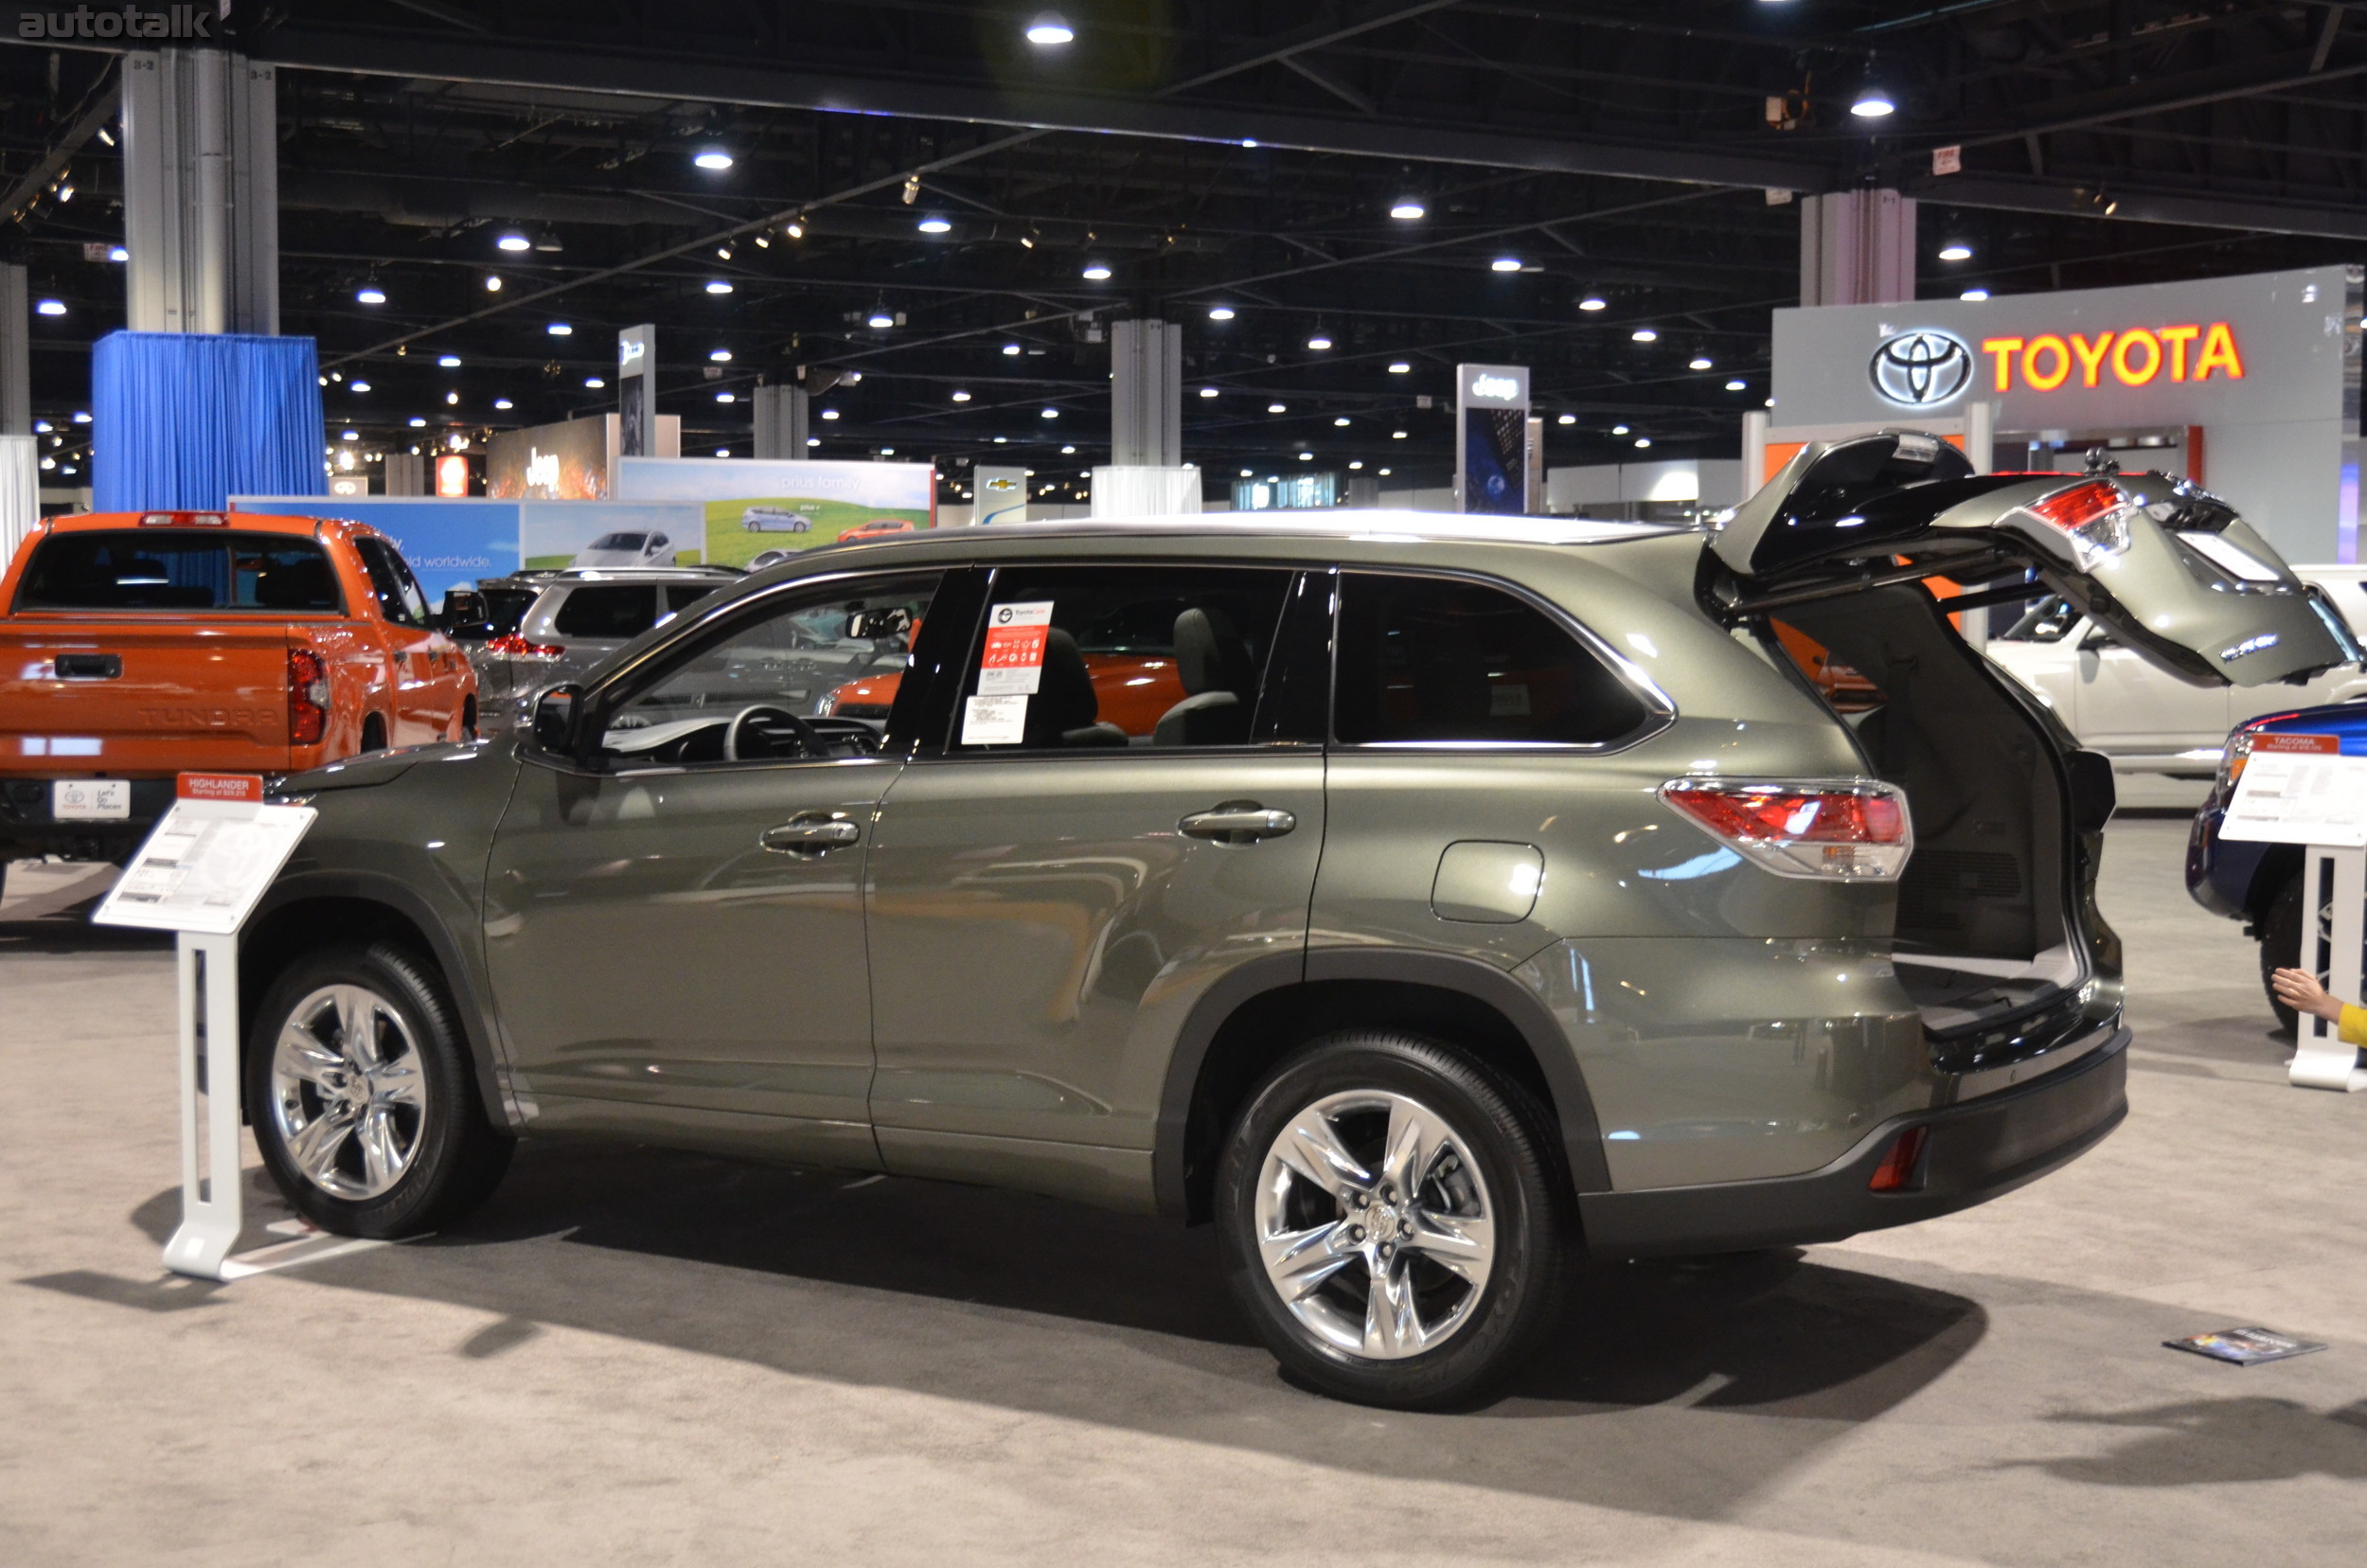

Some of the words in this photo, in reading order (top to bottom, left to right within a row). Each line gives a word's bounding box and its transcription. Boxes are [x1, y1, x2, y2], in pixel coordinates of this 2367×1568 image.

[1982, 321, 2245, 392] TOYOTA
[526, 446, 560, 492] Jeep
[780, 474, 815, 491] prius
[818, 474, 860, 491] family
[423, 555, 492, 568] worldwide.
[139, 708, 278, 726] TUNDRA
[2274, 737, 2315, 745] TACOMA
[189, 777, 249, 791] HIGHLANDER
